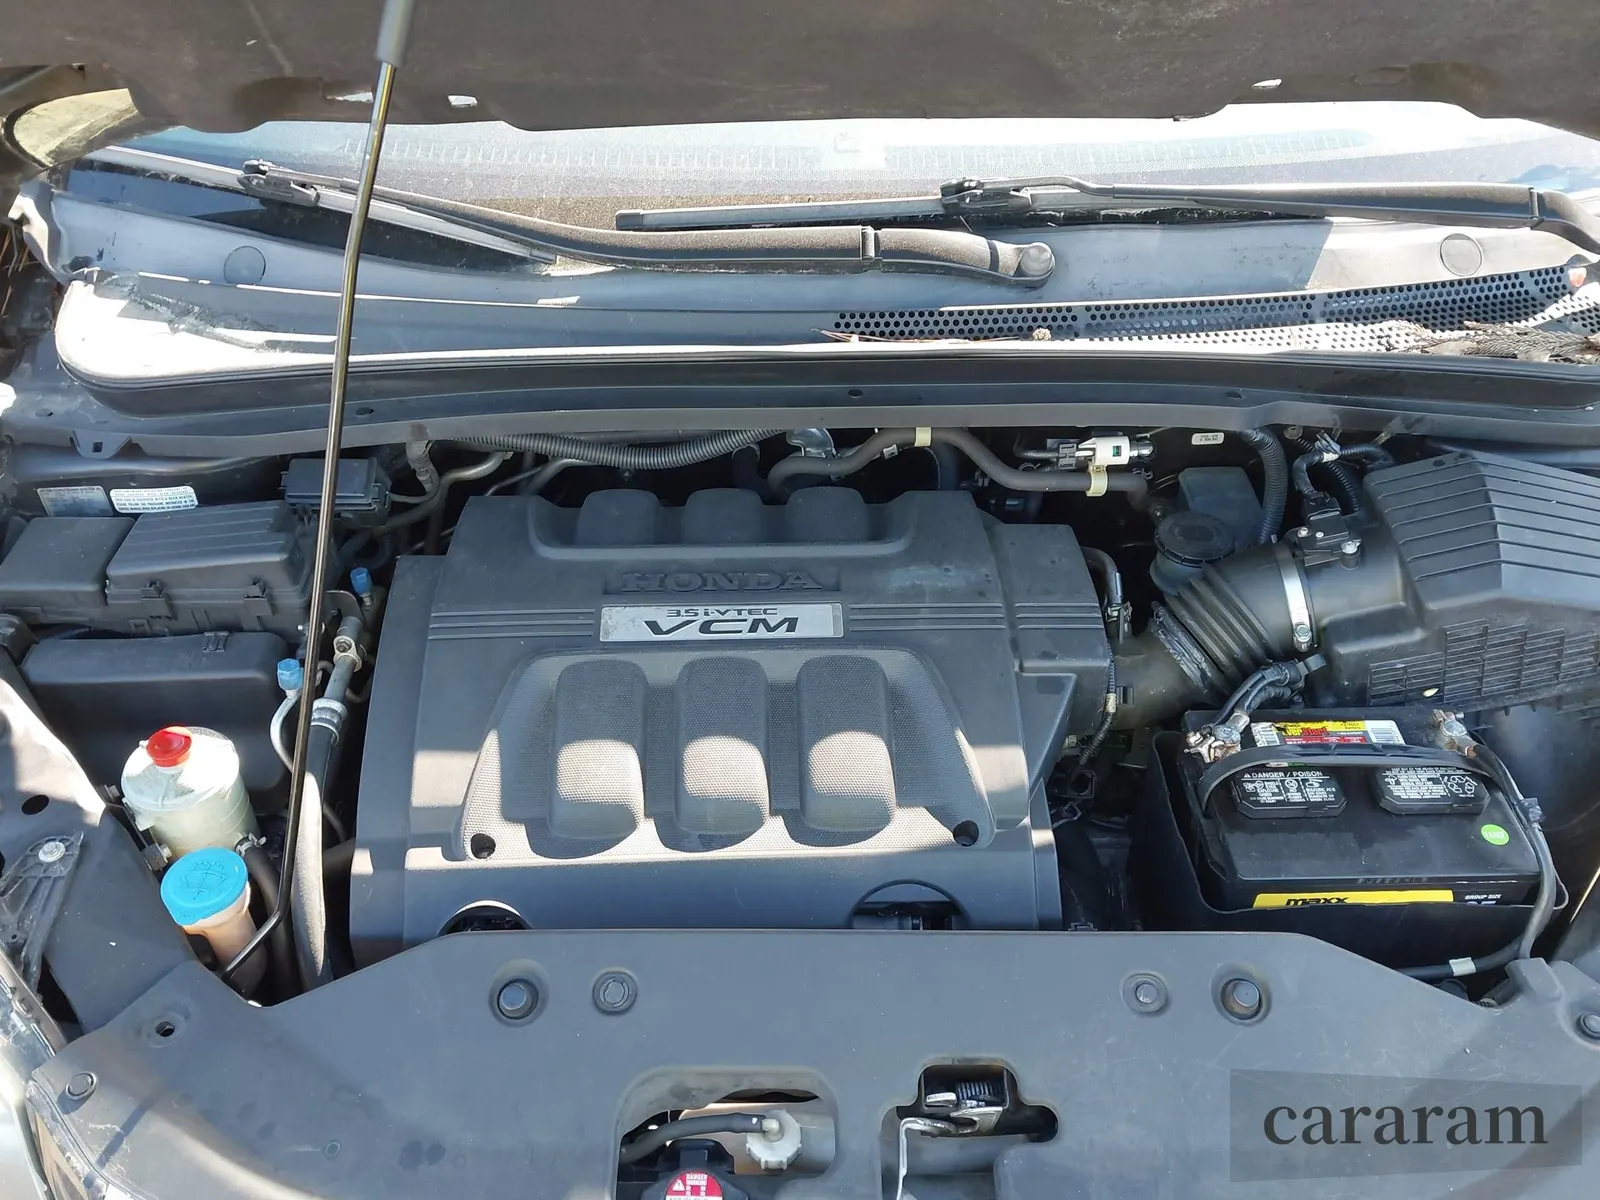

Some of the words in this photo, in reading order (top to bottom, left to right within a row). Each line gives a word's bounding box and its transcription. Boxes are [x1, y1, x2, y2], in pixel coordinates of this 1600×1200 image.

[621, 571, 823, 593] HONDA
[666, 608, 699, 618] 3.5
[703, 607, 778, 617] i-VTEC
[643, 616, 799, 636] VCM
